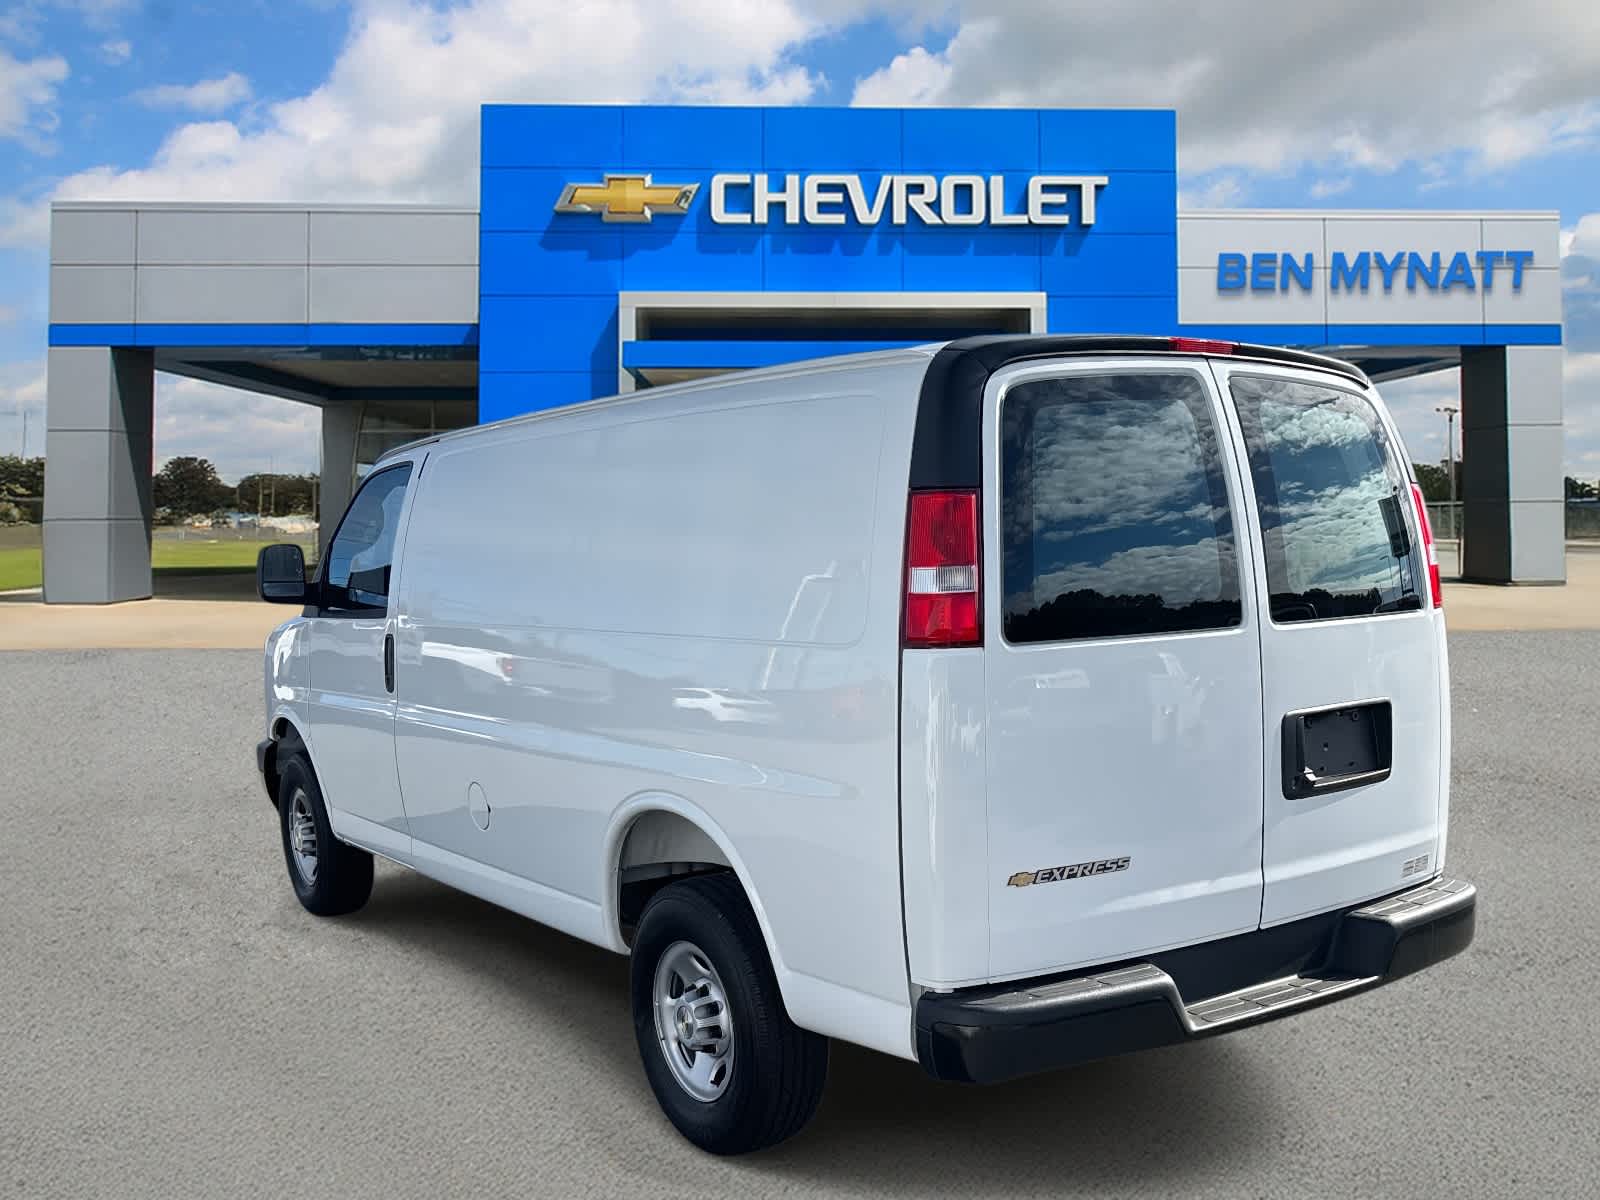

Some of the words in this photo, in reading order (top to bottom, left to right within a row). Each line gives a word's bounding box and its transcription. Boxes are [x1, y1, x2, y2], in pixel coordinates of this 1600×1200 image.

[710, 173, 1109, 226] CHEVROLET
[1217, 252, 1314, 291] BEN
[1330, 250, 1534, 291] MYNATT
[1033, 856, 1132, 885] EXPRESS
